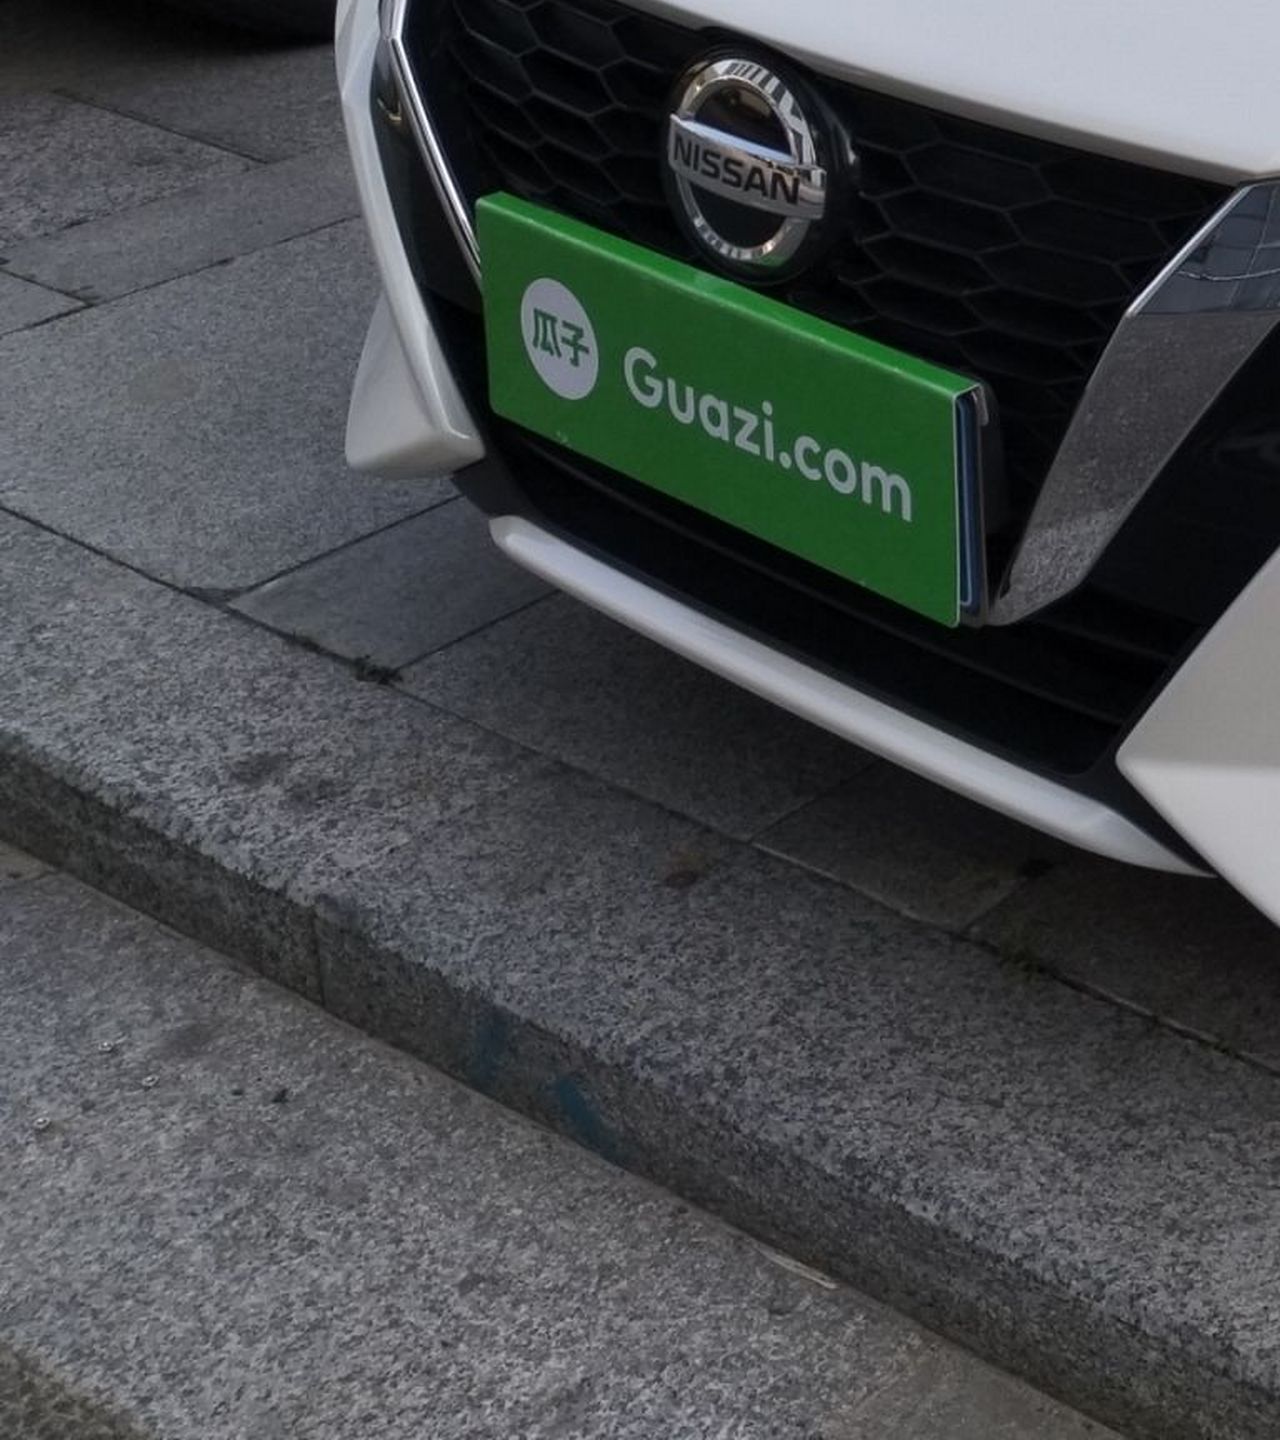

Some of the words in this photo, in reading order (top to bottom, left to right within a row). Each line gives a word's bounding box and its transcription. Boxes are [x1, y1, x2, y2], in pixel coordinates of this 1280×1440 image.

[674, 135, 799, 205] NISSAN
[533, 308, 590, 367] 瓜子
[624, 346, 912, 523] Guazi.com
